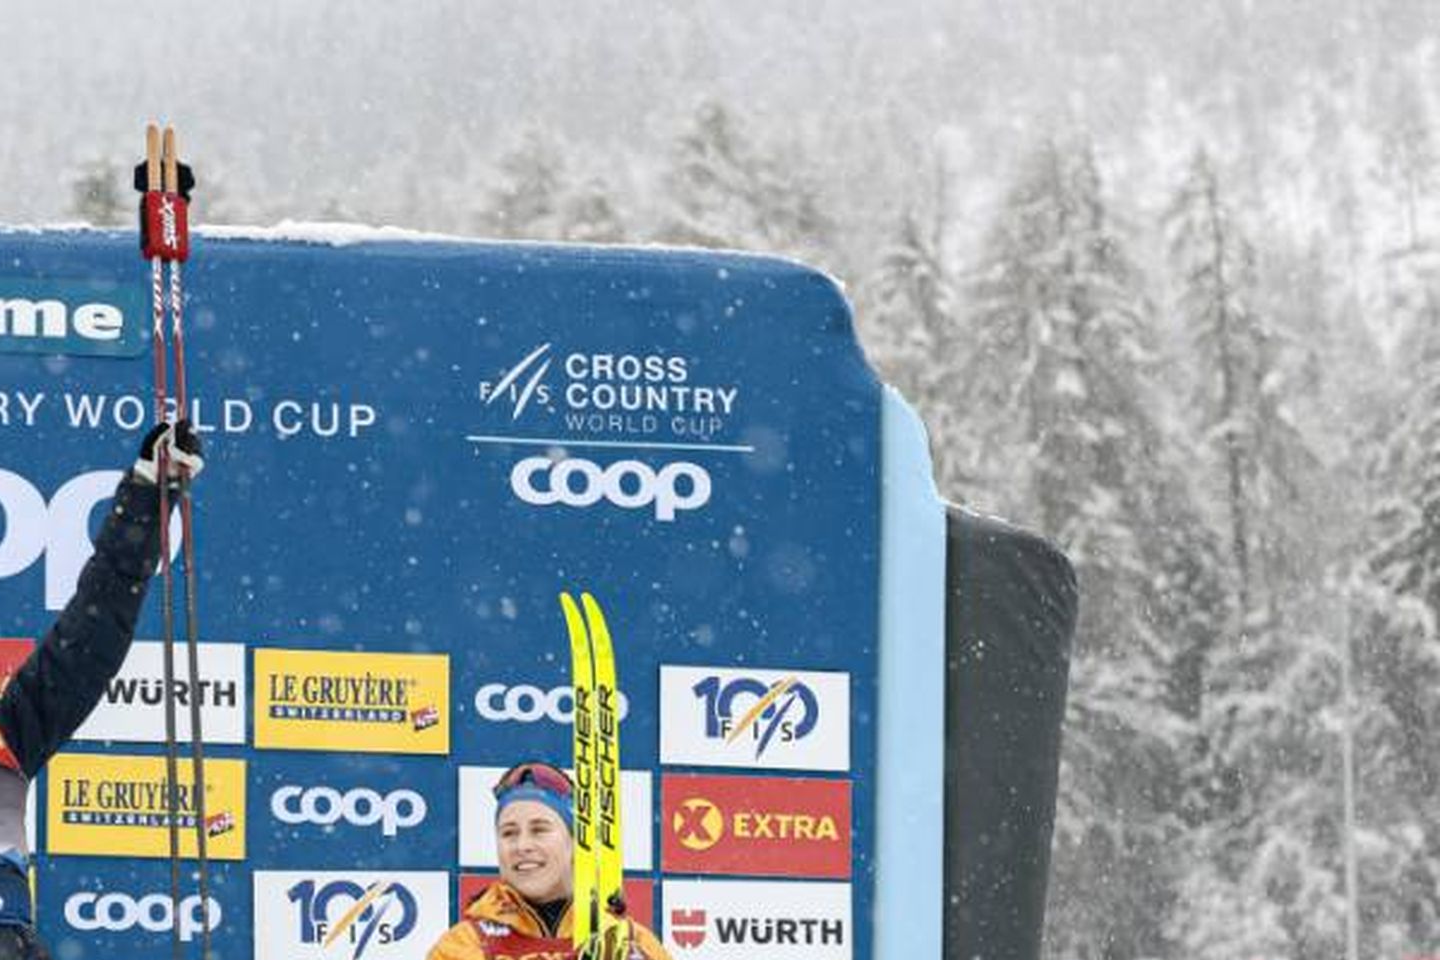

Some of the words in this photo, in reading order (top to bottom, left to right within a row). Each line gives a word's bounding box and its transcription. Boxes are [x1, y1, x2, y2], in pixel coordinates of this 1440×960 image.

[565, 353, 688, 383] CROSS
[565, 383, 738, 414] COUNTRY
[272, 400, 376, 437] CUP
[565, 413, 658, 434] WORLD
[671, 416, 724, 437] CUP
[511, 457, 712, 521] coop
[269, 674, 298, 702] LE
[302, 671, 409, 707] GRUYÈRE
[576, 685, 592, 852] FISCHER
[598, 684, 616, 850] FISCHER
[63, 779, 90, 807] LE
[270, 785, 427, 836] coop
[734, 812, 840, 842] EXTRA
[64, 891, 222, 941] coop
[715, 917, 845, 946] WÜRTH
